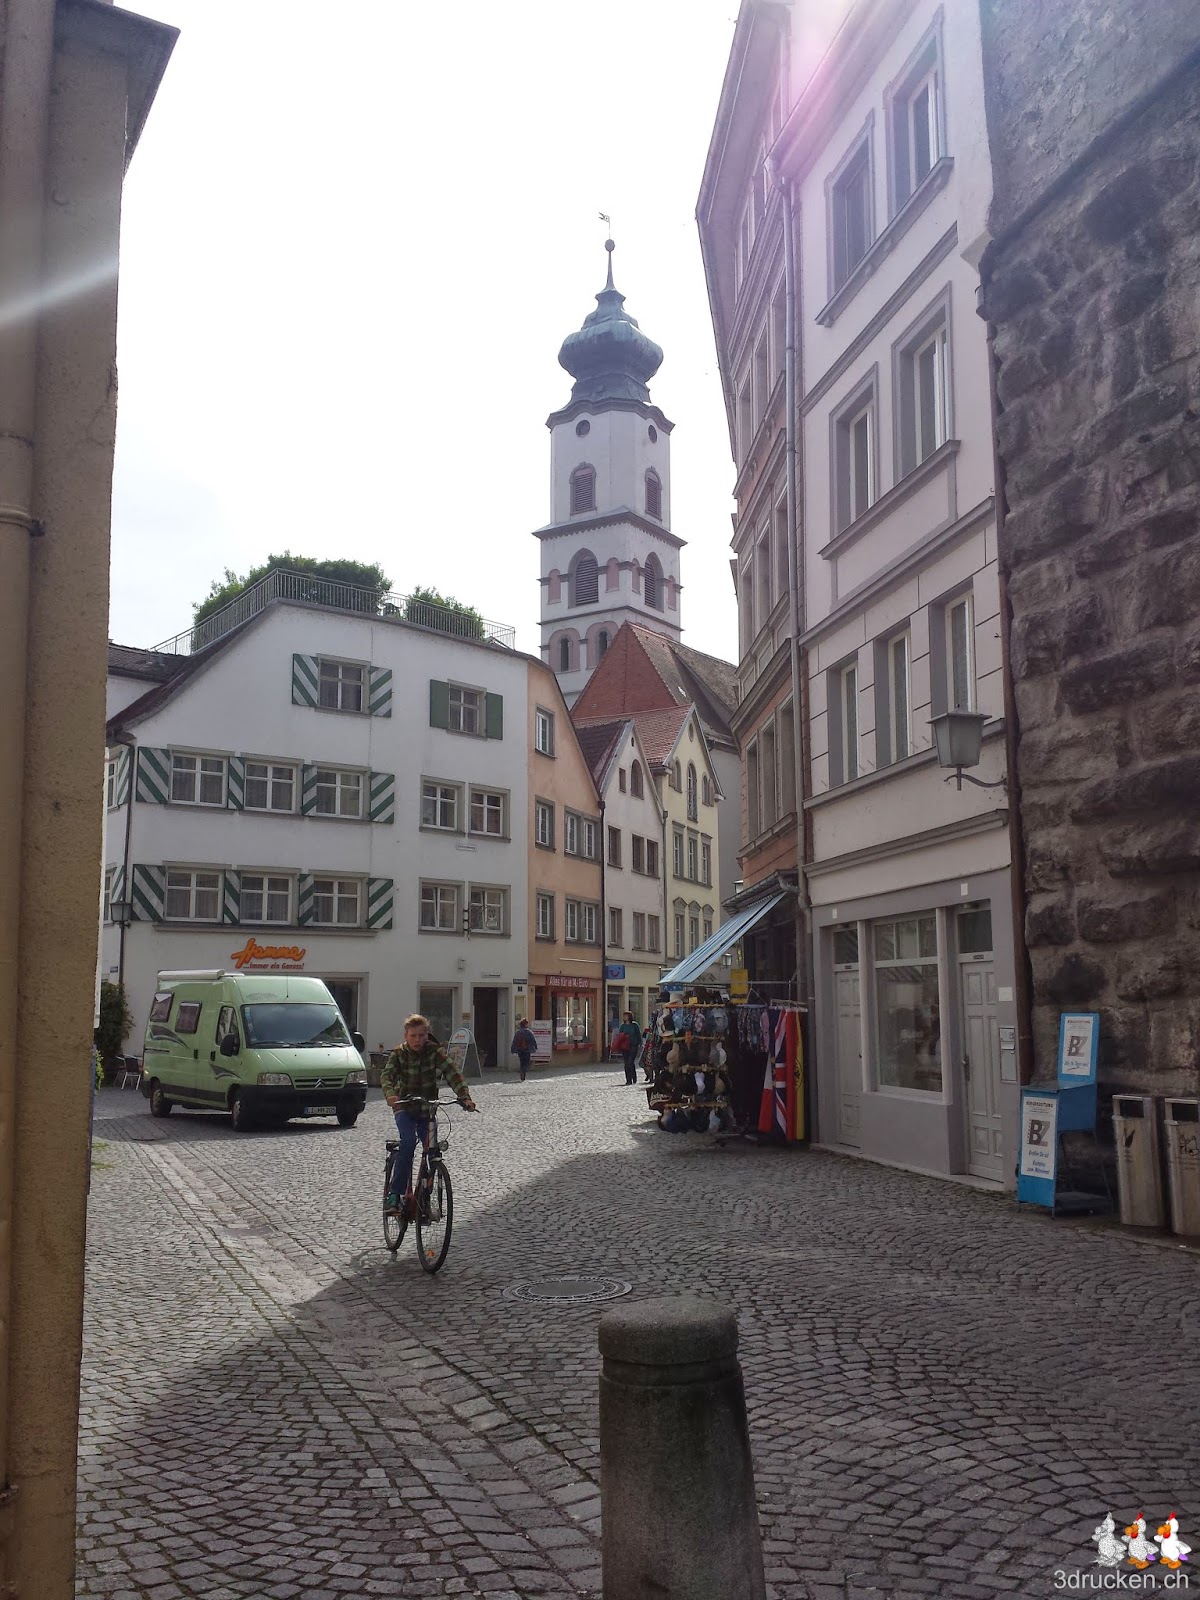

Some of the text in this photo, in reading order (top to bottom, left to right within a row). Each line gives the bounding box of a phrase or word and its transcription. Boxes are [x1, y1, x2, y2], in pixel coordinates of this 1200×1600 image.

[548, 976, 560, 986] Alles
[579, 978, 589, 988] Euro
[1068, 1035, 1088, 1057] BZ
[1028, 1119, 1050, 1147] BZ
